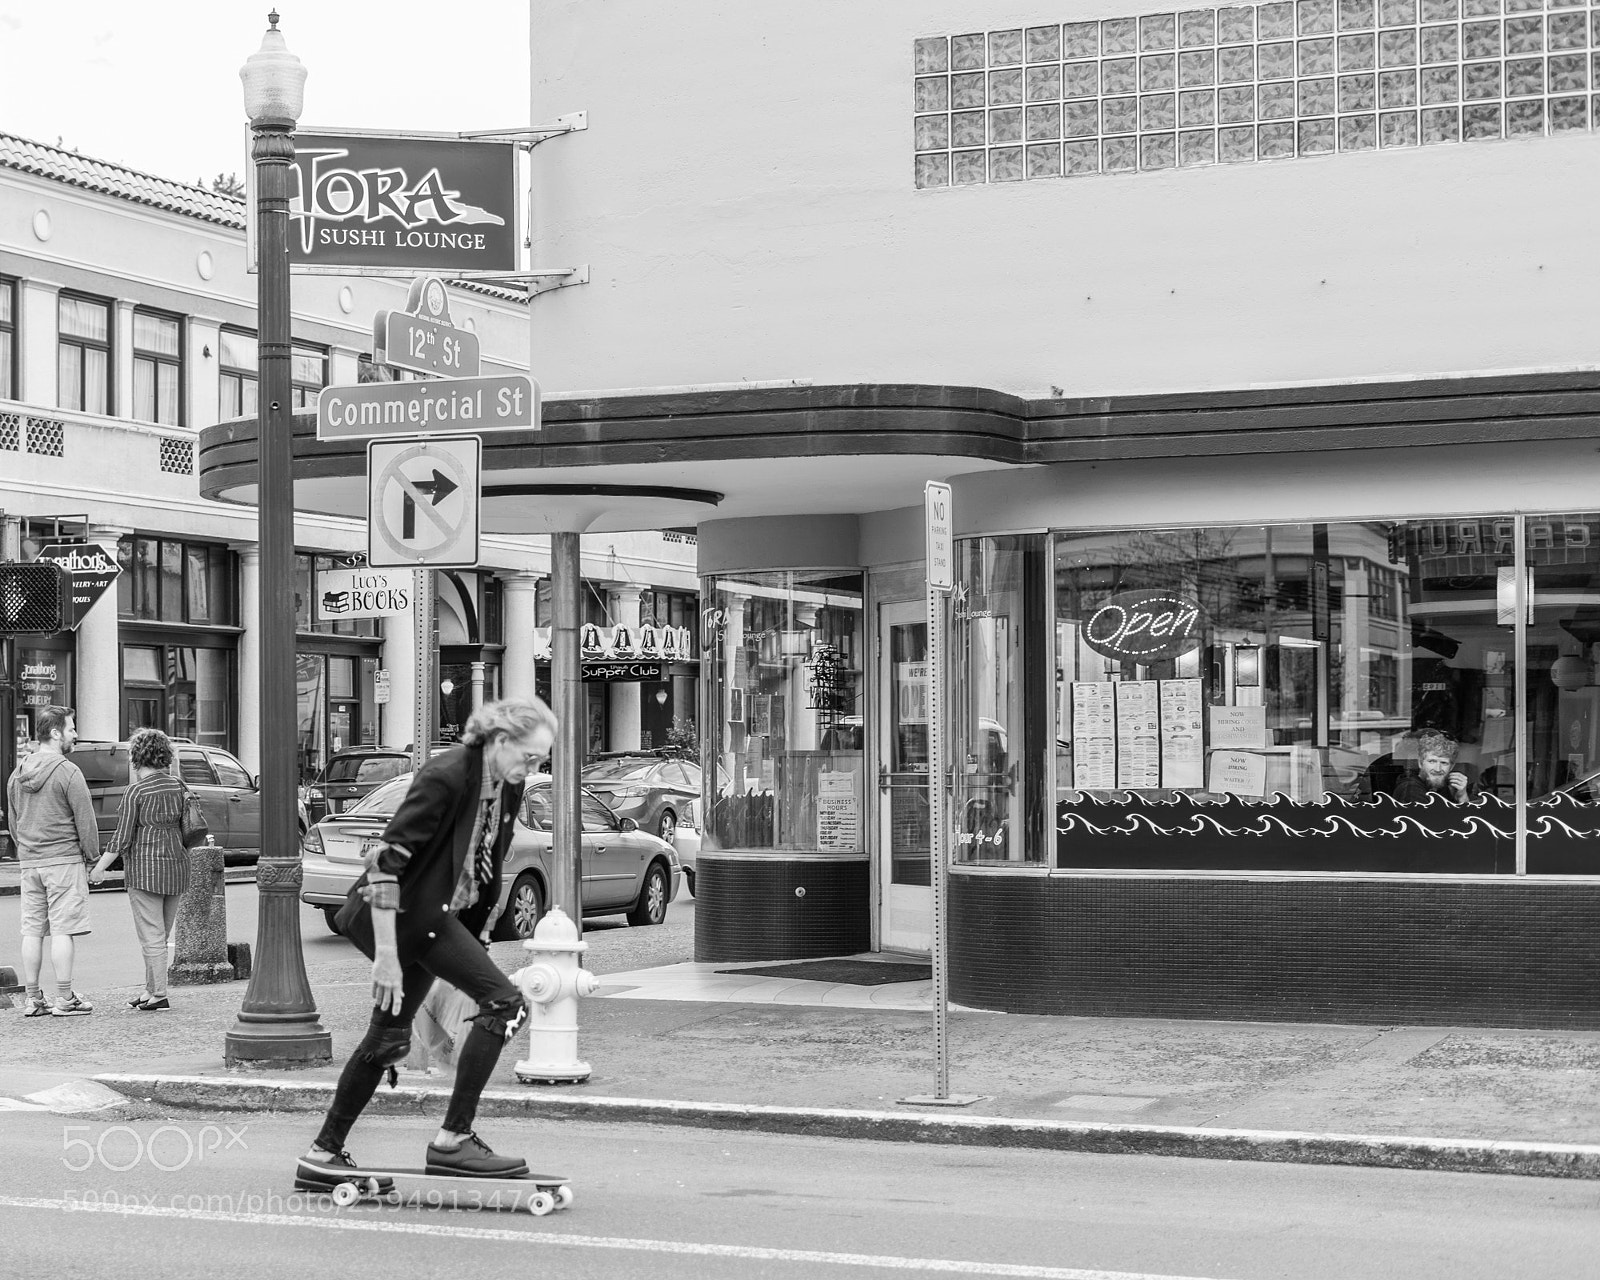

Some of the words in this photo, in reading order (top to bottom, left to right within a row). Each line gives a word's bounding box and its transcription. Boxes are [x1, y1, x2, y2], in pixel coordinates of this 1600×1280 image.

[290, 148, 466, 254] TORA
[320, 228, 386, 247] SUSHI
[395, 230, 486, 250] LOUNGE
[408, 326, 435, 360] 12th
[442, 336, 461, 369] St
[327, 389, 482, 427] Commercial
[496, 386, 524, 417] St
[933, 501, 945, 521] NO
[352, 574, 388, 590] LUCY'S
[351, 588, 408, 611] BOOKS
[742, 632, 766, 642] ounge
[1086, 604, 1200, 648] Open
[582, 665, 626, 679] Supper
[630, 664, 660, 676] Club
[909, 667, 928, 678] WE'RE
